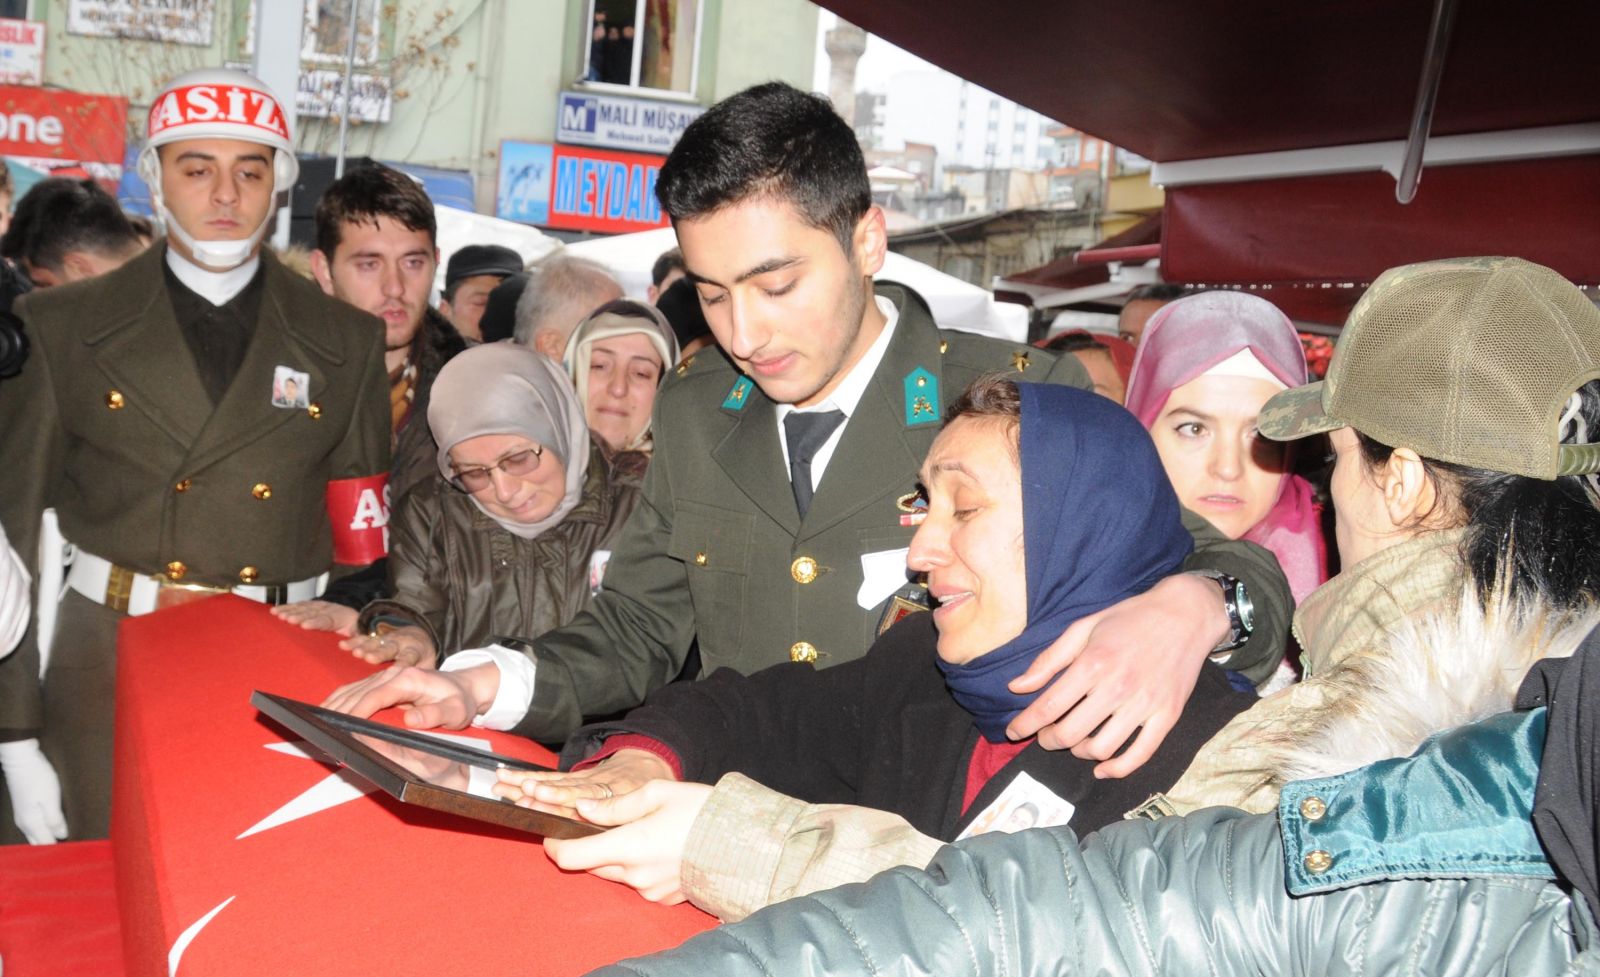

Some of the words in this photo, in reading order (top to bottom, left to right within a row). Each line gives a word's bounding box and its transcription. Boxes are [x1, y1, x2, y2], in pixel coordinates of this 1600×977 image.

[600, 104, 638, 126] MALİ
[642, 107, 696, 133] MÜŞAV
[553, 155, 662, 224] MEYDAN
